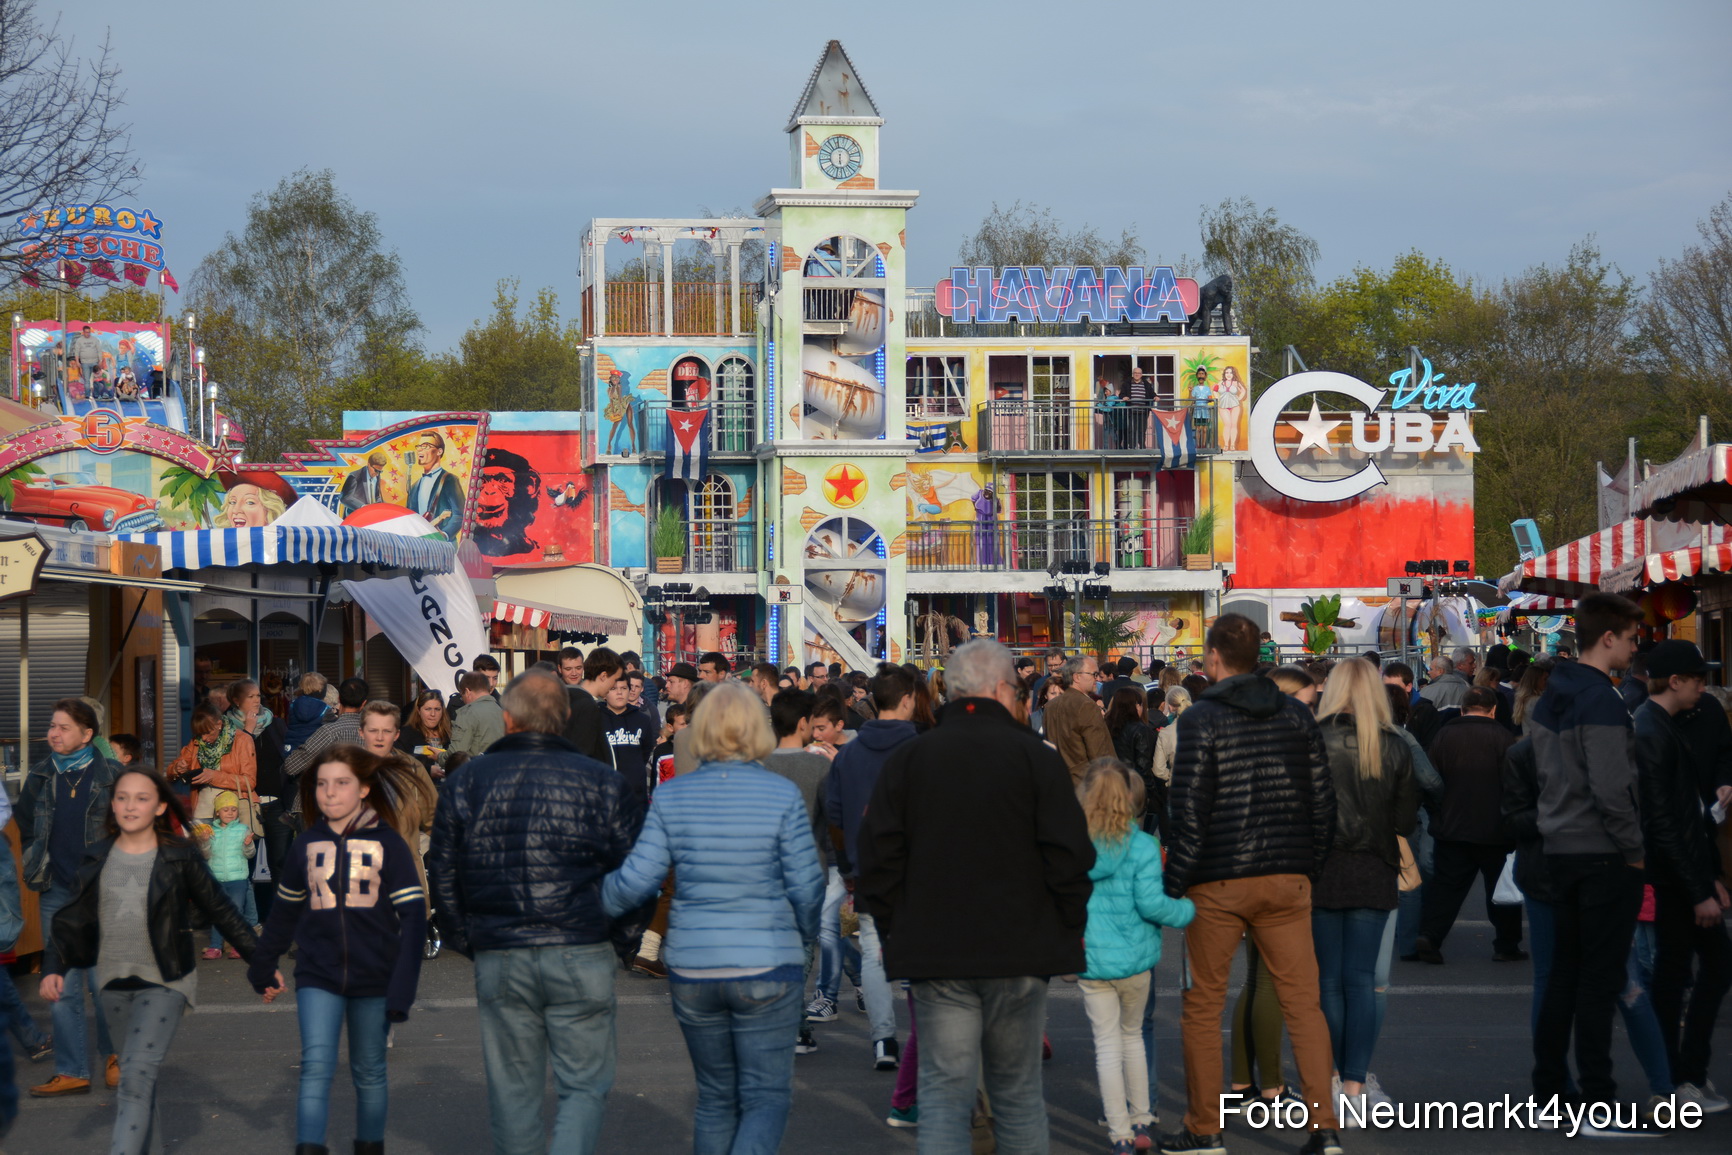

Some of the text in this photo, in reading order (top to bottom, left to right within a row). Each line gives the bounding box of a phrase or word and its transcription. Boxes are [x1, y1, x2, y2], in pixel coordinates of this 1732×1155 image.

[41, 206, 137, 230] EURO
[944, 285, 1189, 309] DISCOTECA
[950, 265, 1189, 323] HAVANA
[1389, 358, 1477, 410] Viva
[1250, 370, 1481, 503] CUBA
[22, 542, 37, 557] NEU
